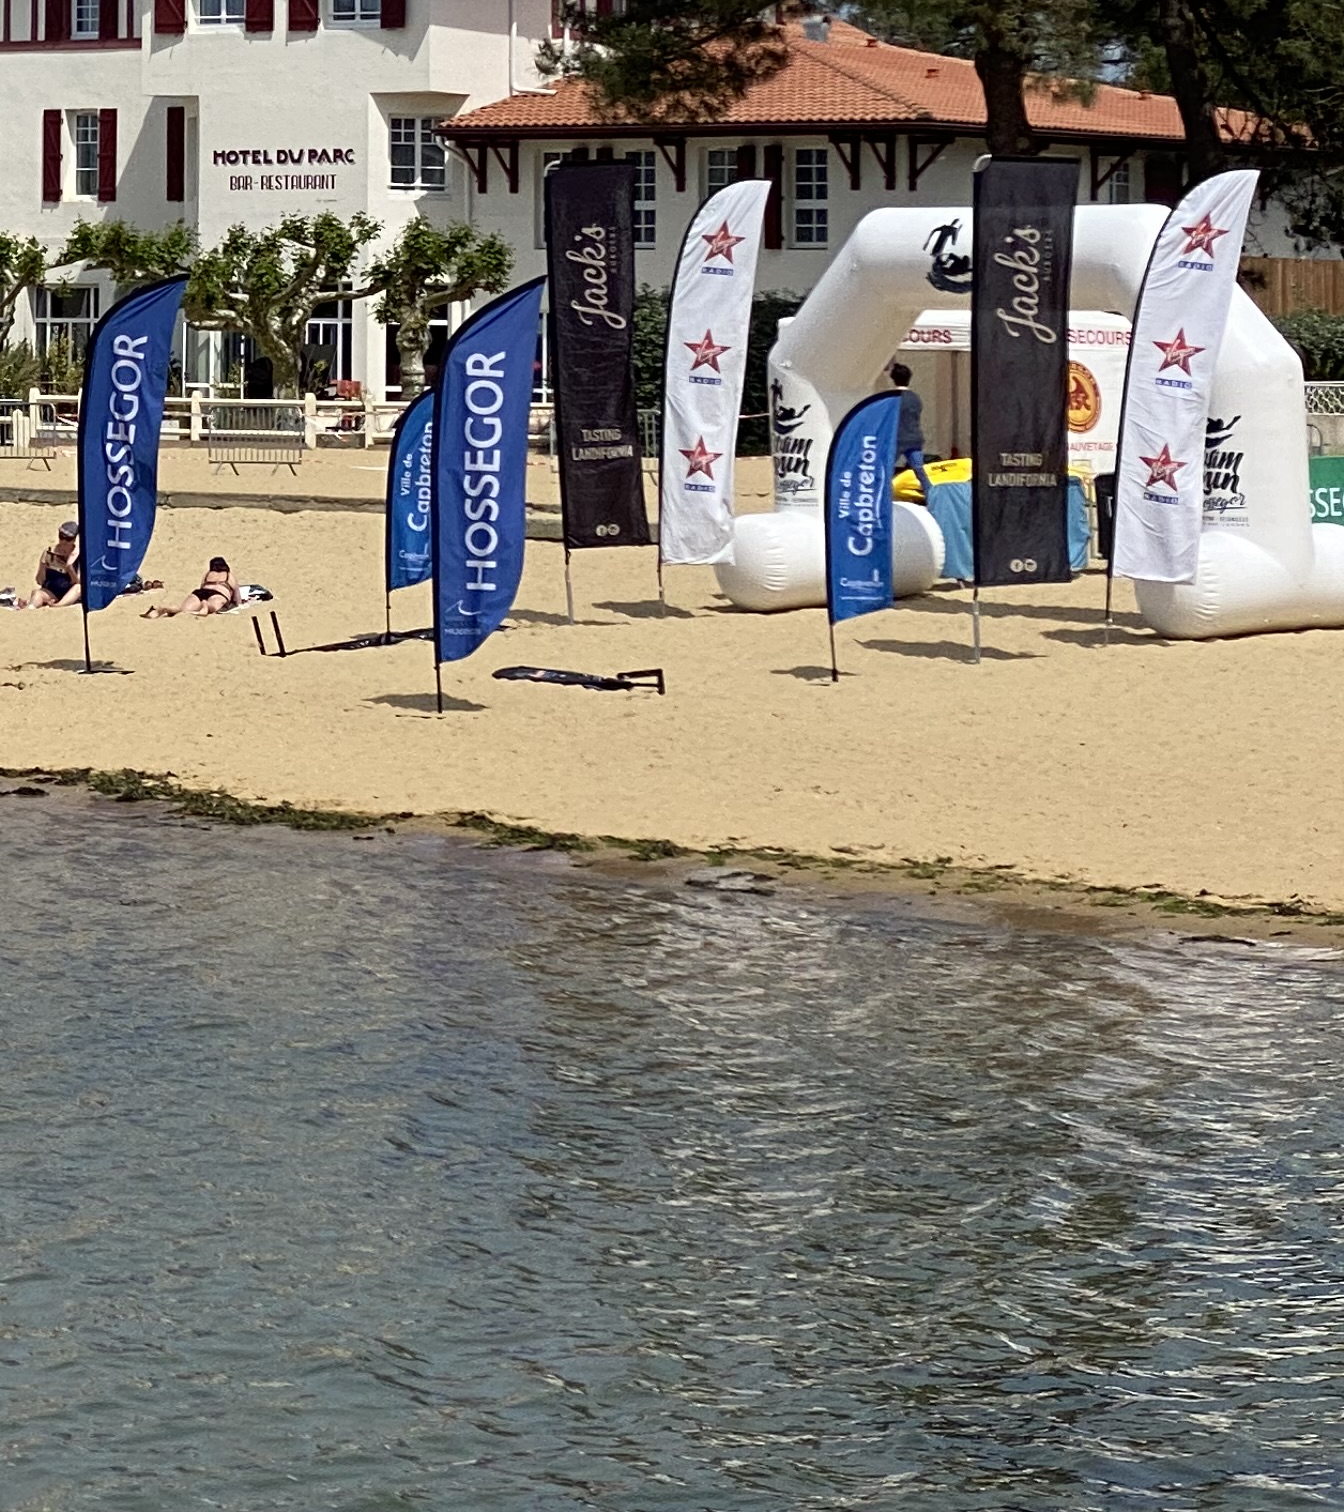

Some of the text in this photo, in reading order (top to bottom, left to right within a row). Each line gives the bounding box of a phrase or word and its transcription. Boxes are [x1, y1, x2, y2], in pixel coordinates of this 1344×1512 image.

[213, 148, 355, 165] HOTEL DU PARC
[566, 223, 627, 330] Jack's
[993, 225, 1057, 344] Jack's
[106, 334, 148, 550] HOSSEGOR
[463, 351, 507, 591] HOSSEGOR
[581, 428, 622, 442] TASTING
[1000, 453, 1043, 467] TASTING
[1067, 442, 1115, 452] AUVETAGE
[838, 471, 852, 519] Ville de
[848, 435, 878, 556] Capbreton
